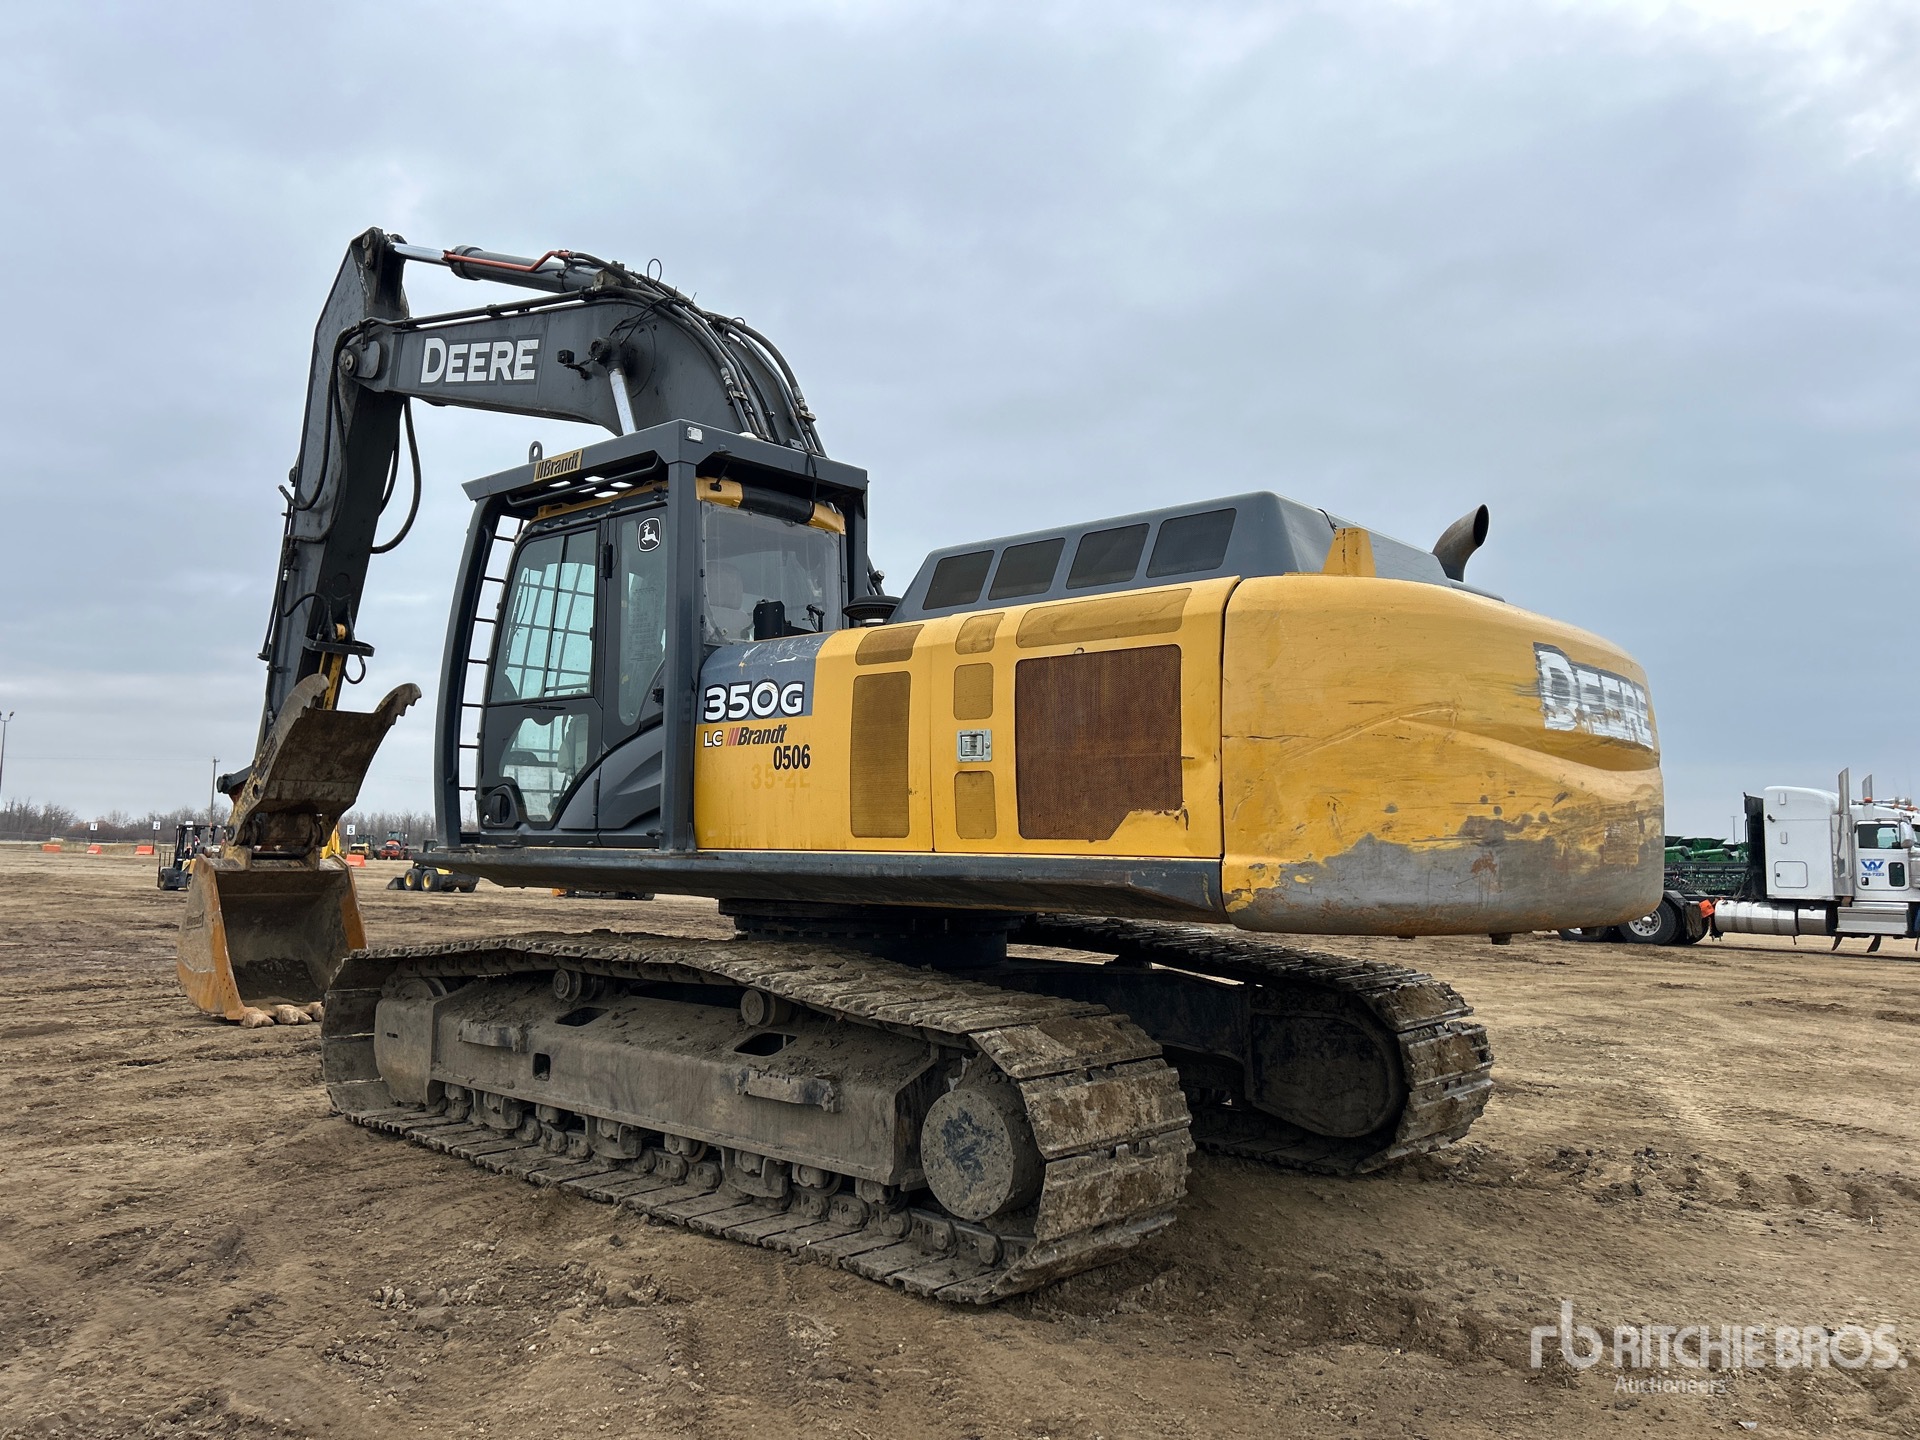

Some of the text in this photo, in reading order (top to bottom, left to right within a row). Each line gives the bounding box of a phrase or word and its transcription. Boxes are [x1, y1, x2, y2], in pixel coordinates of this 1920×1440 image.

[421, 337, 539, 383] DEERE
[543, 451, 579, 478] Brandt
[703, 679, 805, 722] 350G
[704, 724, 787, 747] LC Brandt
[773, 744, 811, 770] 0506
